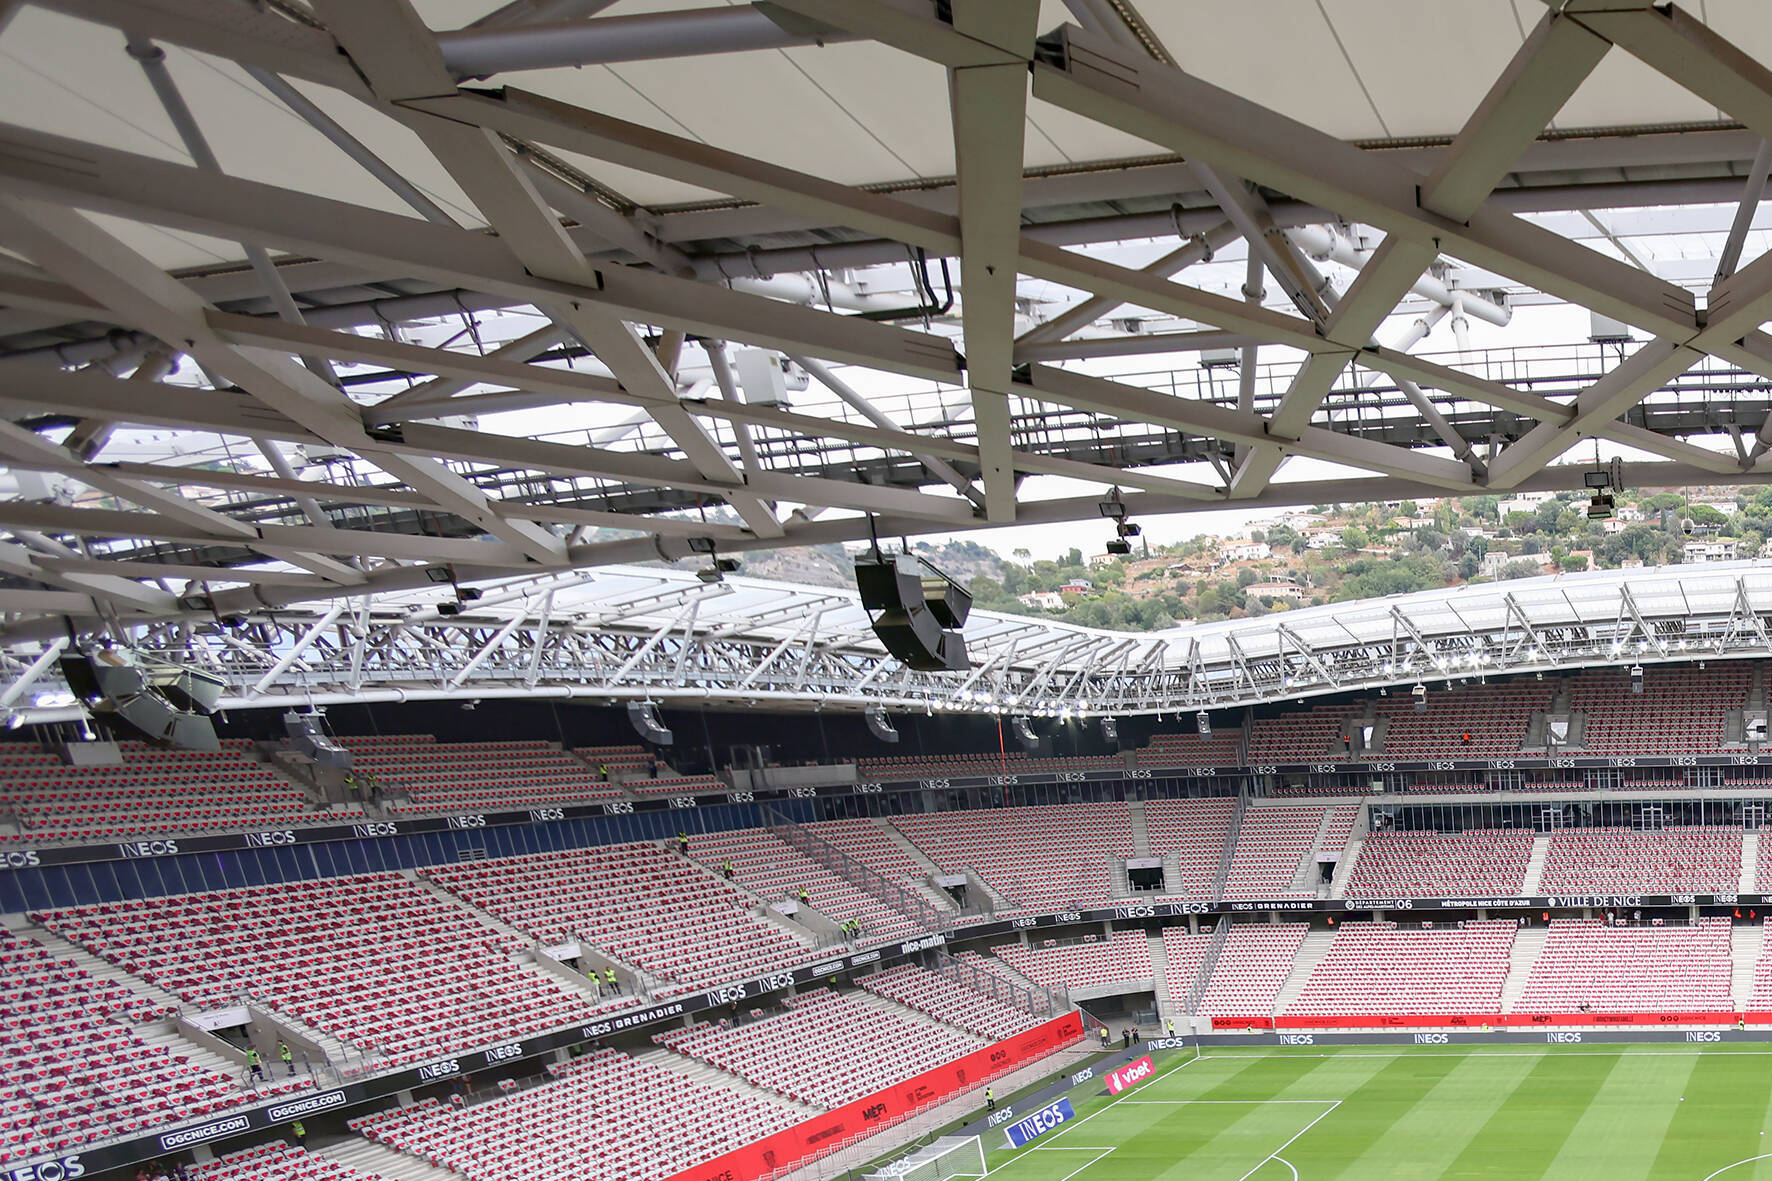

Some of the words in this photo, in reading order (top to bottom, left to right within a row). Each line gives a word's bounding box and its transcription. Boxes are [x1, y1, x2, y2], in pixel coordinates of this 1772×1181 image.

[1428, 760, 1455, 770] INEOS
[1669, 757, 1697, 766] INEOS
[1056, 772, 1085, 782] INEOS
[1250, 765, 1277, 776] INEOS
[852, 783, 882, 794] INEOS
[668, 796, 696, 808] INEOS
[447, 814, 486, 829] INEOS
[119, 840, 178, 858] INEOS
[1397, 900, 1412, 909] 06
[1559, 896, 1589, 906] VILLE
[1594, 896, 1609, 906] DE
[1613, 896, 1641, 906] NICE
[1713, 895, 1737, 903] INEOS
[1115, 906, 1155, 919] INEOS
[1171, 903, 1209, 915] INEOS
[1012, 918, 1037, 928] INEOS
[1055, 912, 1081, 923] INEOS
[901, 934, 945, 954] nice-matin
[759, 973, 794, 993] INEOS
[708, 986, 746, 1007] INEOS
[583, 1020, 611, 1038] INEOS
[615, 1005, 683, 1028] GRENADIER
[1279, 1035, 1314, 1045] INEOS
[1414, 1033, 1448, 1044] INEOS
[1547, 1033, 1582, 1043] INEOS
[1686, 1032, 1720, 1042] INEOS
[1148, 1037, 1184, 1051] INEOS
[486, 1043, 522, 1063] INEOS
[419, 1060, 460, 1080] INEOS
[1072, 1067, 1093, 1085] INEOS
[1121, 1060, 1151, 1084] vbet
[273, 1093, 342, 1118] OGCNICE.COM
[988, 1106, 1013, 1128] INEOS
[1018, 1104, 1065, 1142] INEOS
[166, 1118, 245, 1146] OGCNICE.COM
[880, 1156, 911, 1181] INEOS
